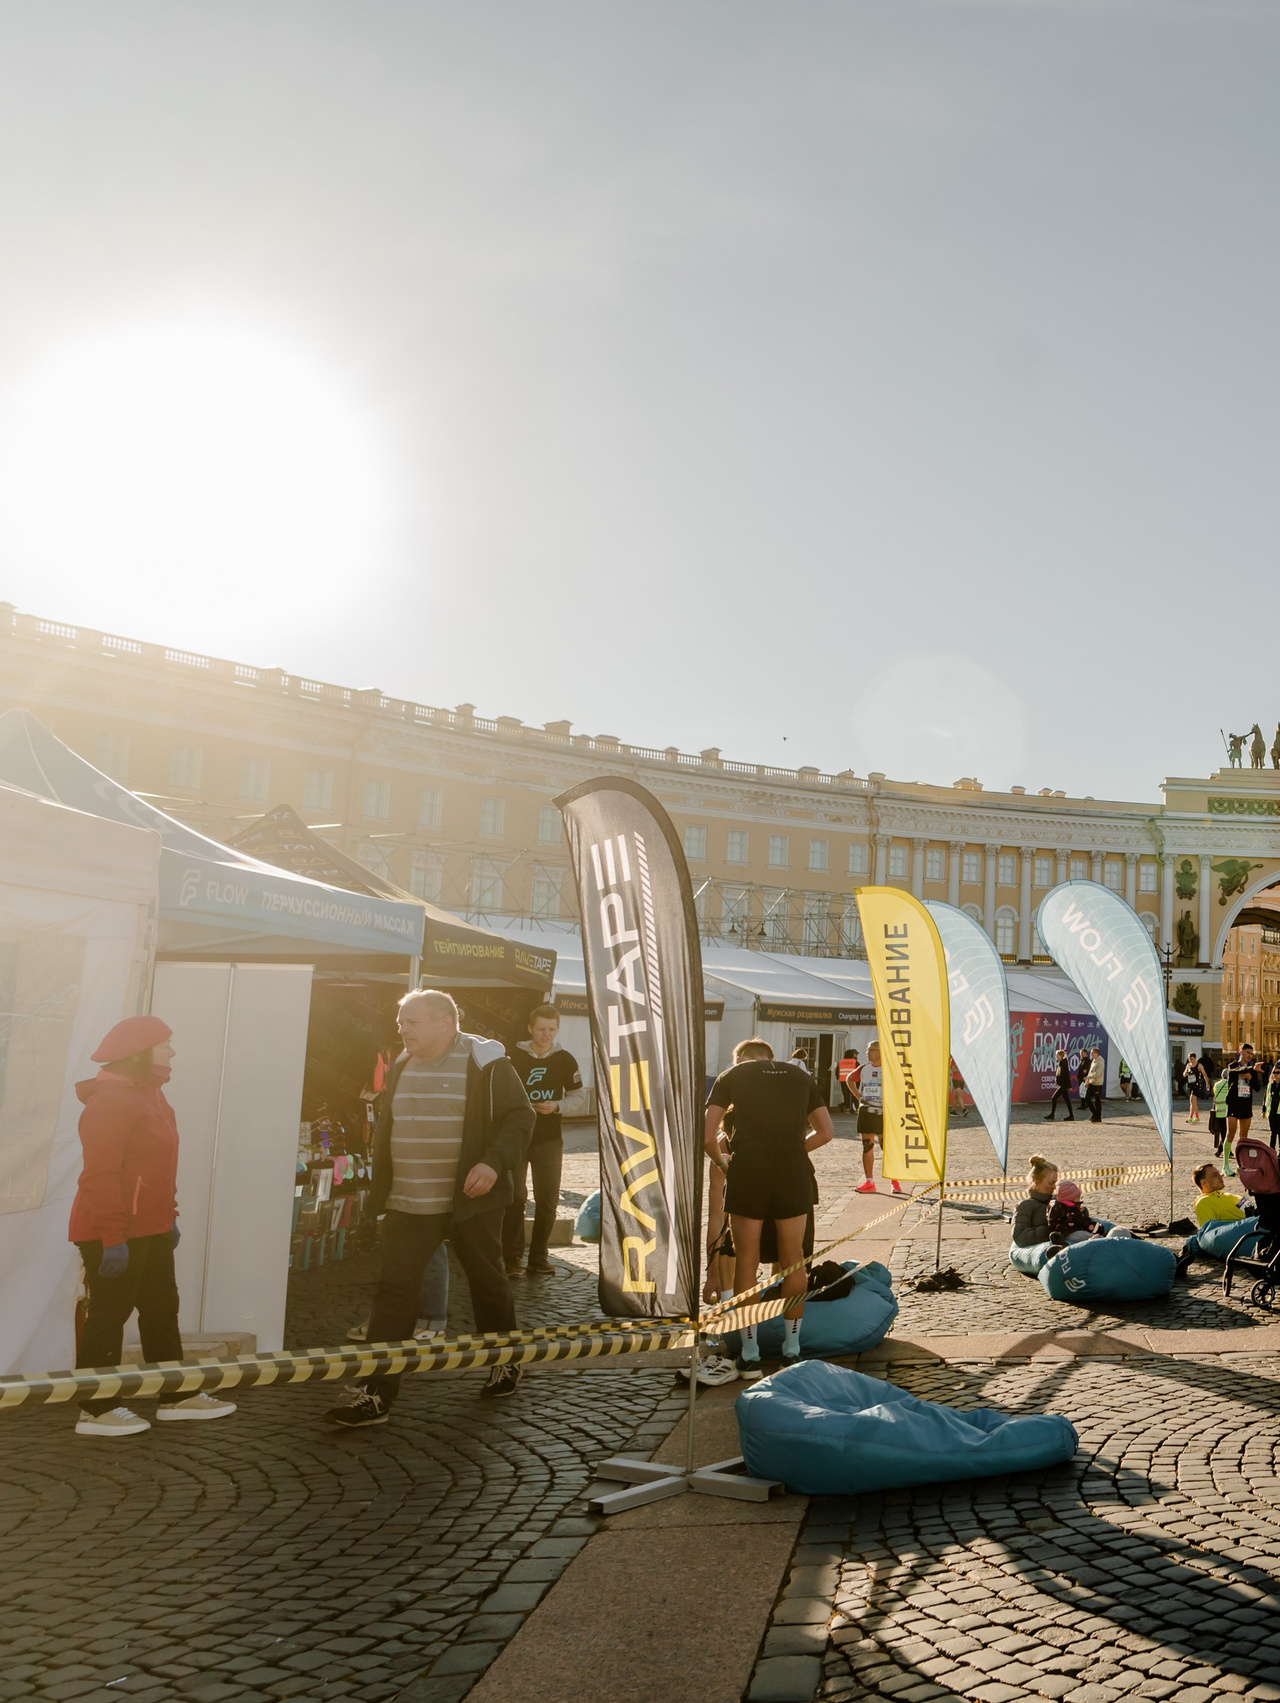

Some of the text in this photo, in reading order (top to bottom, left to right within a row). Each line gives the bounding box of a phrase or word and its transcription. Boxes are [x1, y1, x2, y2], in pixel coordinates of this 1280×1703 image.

[206, 880, 249, 906] FLOW
[261, 891, 415, 936] ПЕРКУССИОННЫЙ МАССАЖ
[433, 939, 505, 959] ТЕЙПИРОВАНИЕ
[559, 999, 588, 1011] Женск
[529, 1090, 554, 1101] OW
